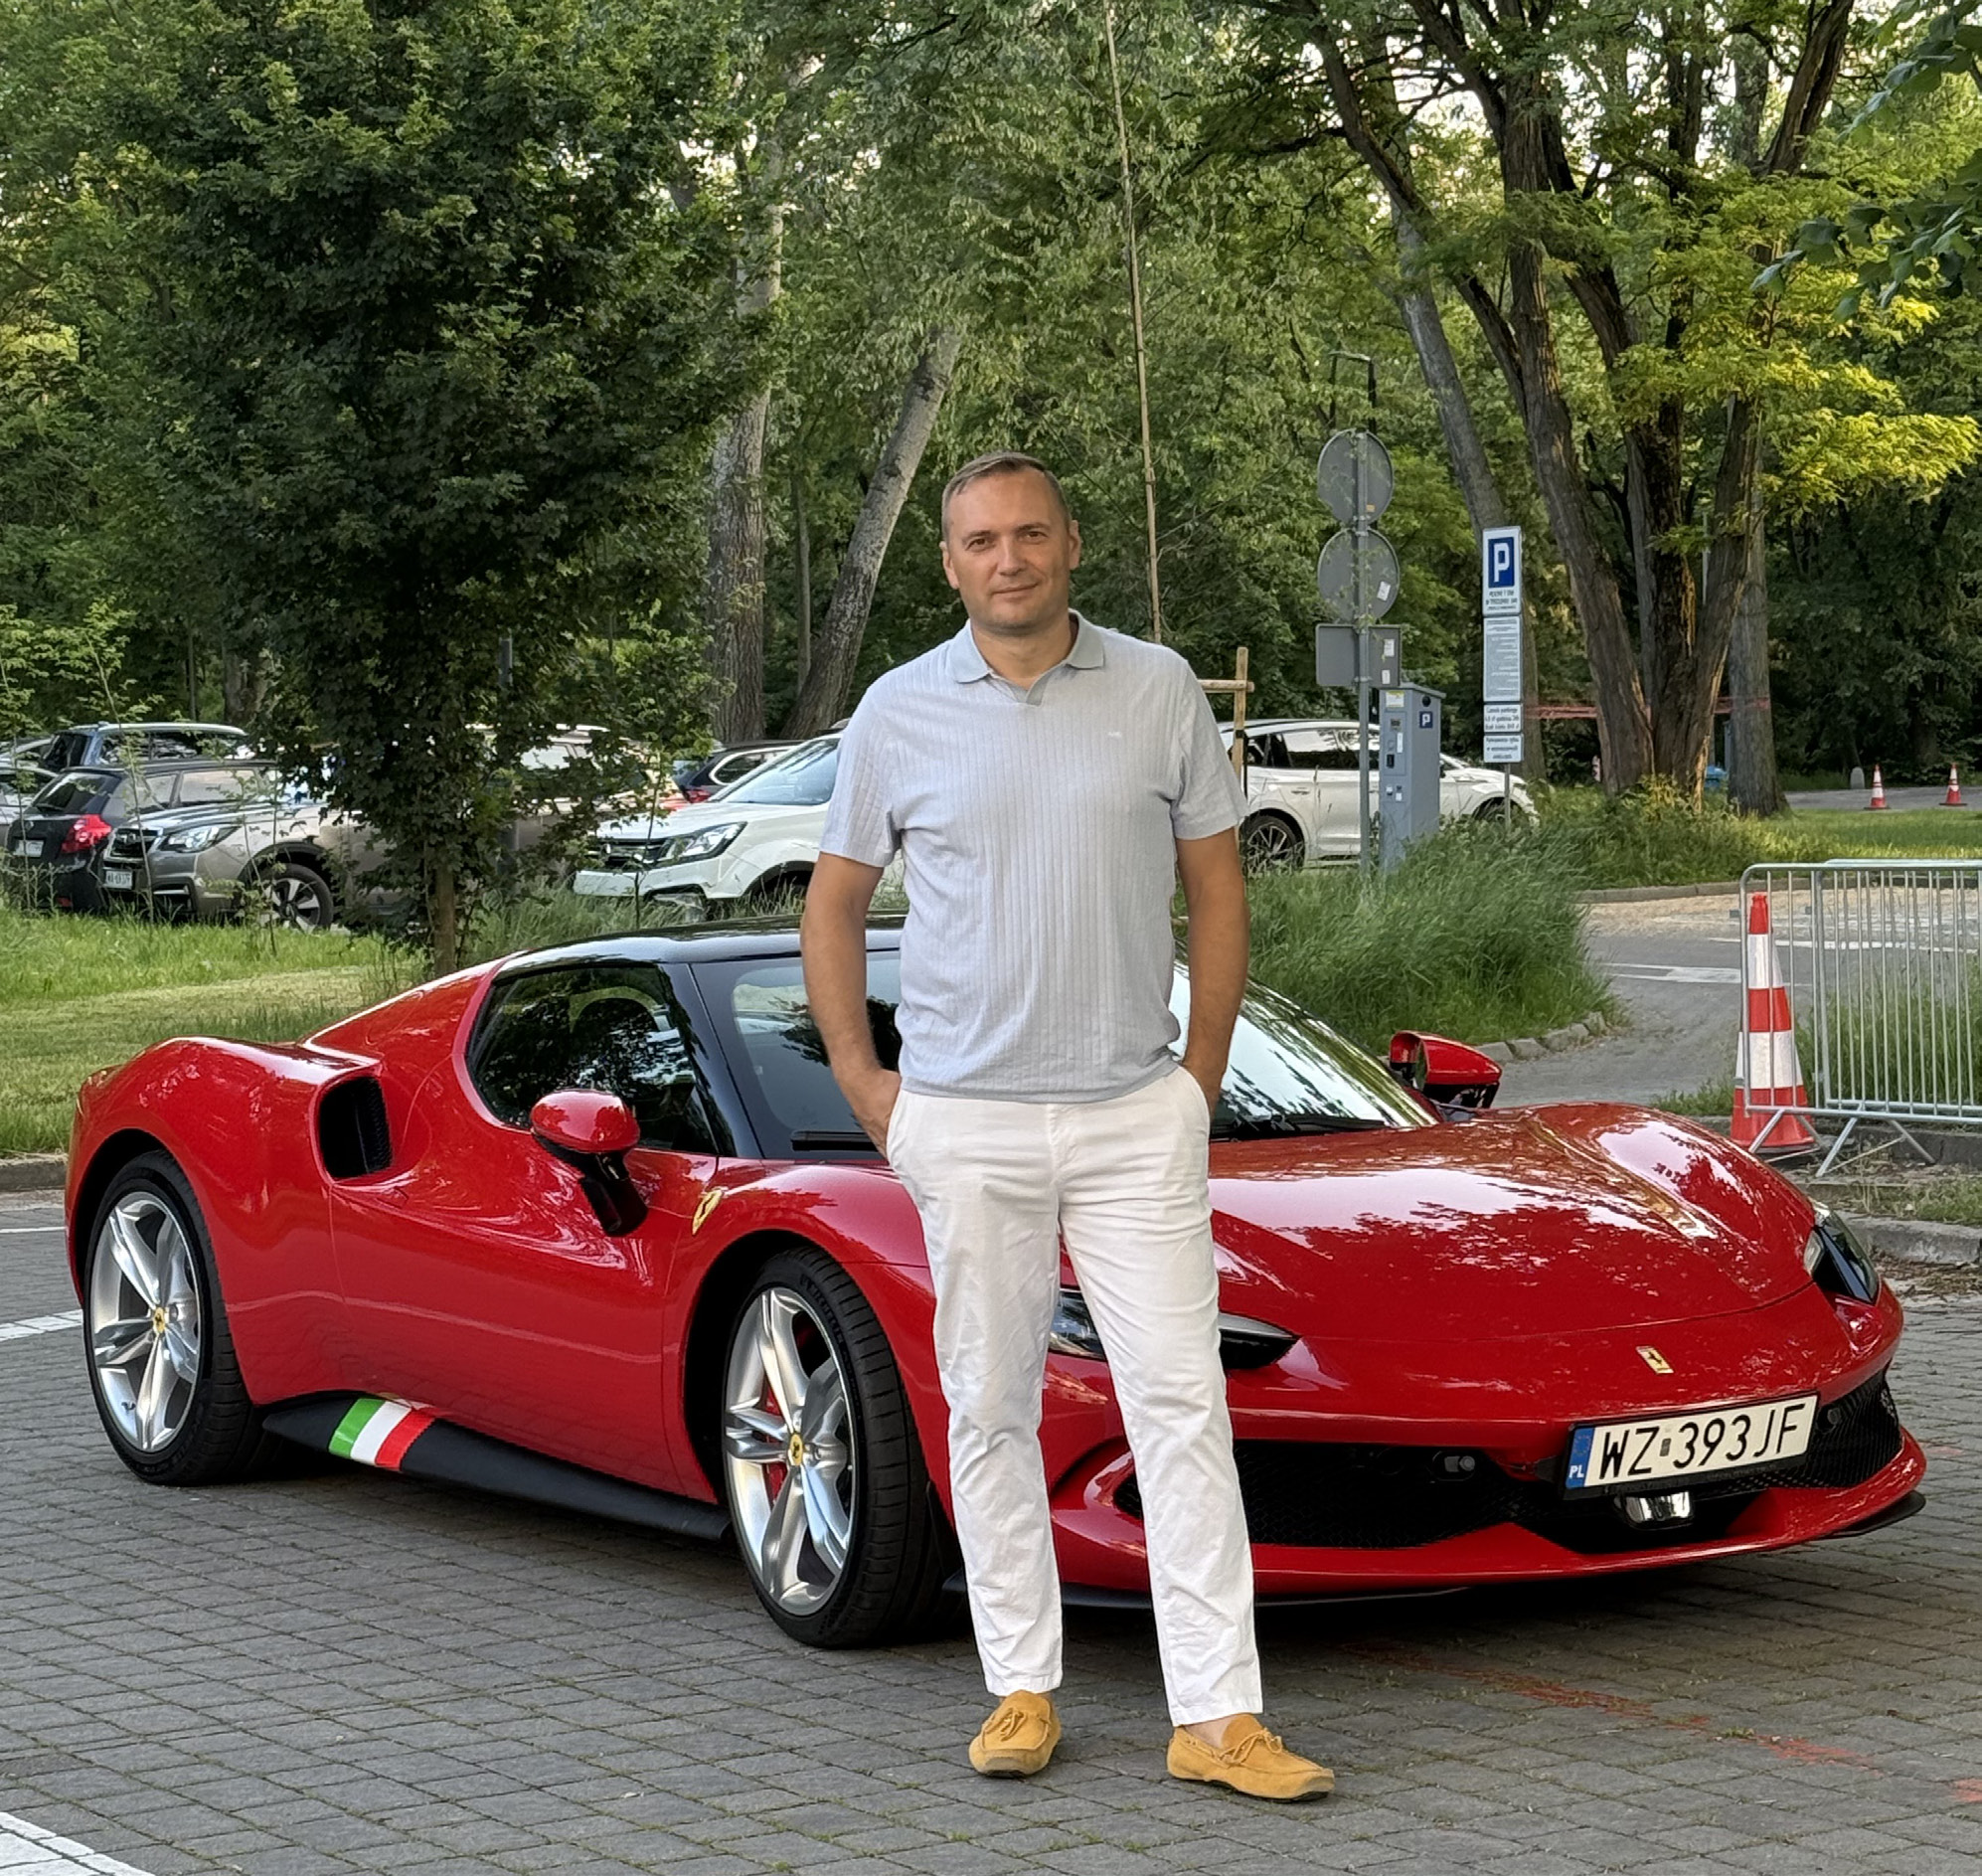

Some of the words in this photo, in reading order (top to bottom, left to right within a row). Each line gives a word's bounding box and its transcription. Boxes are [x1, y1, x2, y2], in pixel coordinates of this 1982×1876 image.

[1493, 543, 1510, 583] P
[1421, 714, 1431, 727] P
[1598, 1427, 1660, 1479] WZ
[1673, 1403, 1805, 1468] 393JF
[1569, 1464, 1584, 1479] PL
